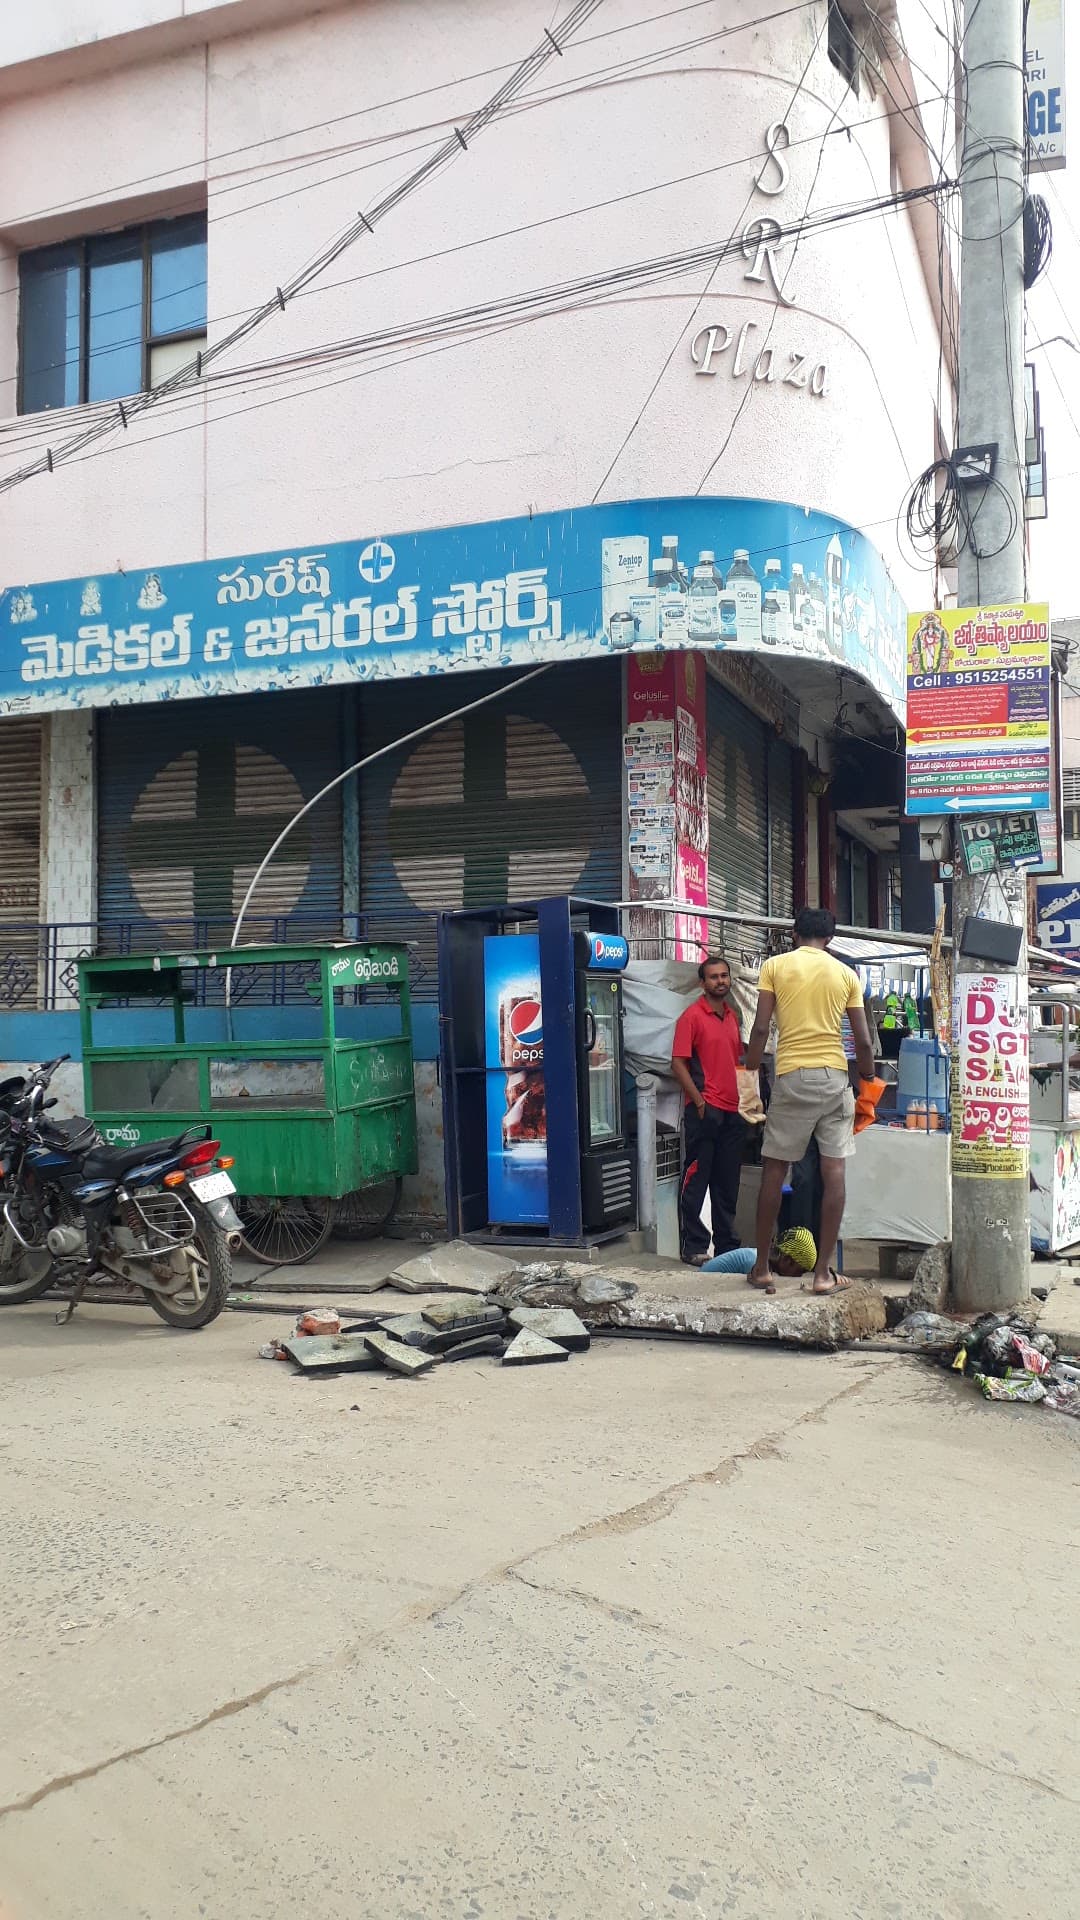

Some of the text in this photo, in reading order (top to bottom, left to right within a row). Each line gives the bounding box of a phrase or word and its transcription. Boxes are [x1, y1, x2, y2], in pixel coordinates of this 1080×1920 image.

[690, 319, 830, 400] Plaza
[216, 552, 333, 605] సురేష్
[20, 613, 194, 683] మెడికల్
[244, 585, 420, 659] జనరల్
[431, 567, 563, 658] స్టోర్స్
[913, 674, 941, 688] Cell
[955, 667, 1043, 685] 9515254551
[962, 814, 1033, 841] TO-LET
[605, 943, 624, 959] pepsi
[512, 1048, 544, 1063] peps
[975, 1085, 1020, 1099] ENGLISH
